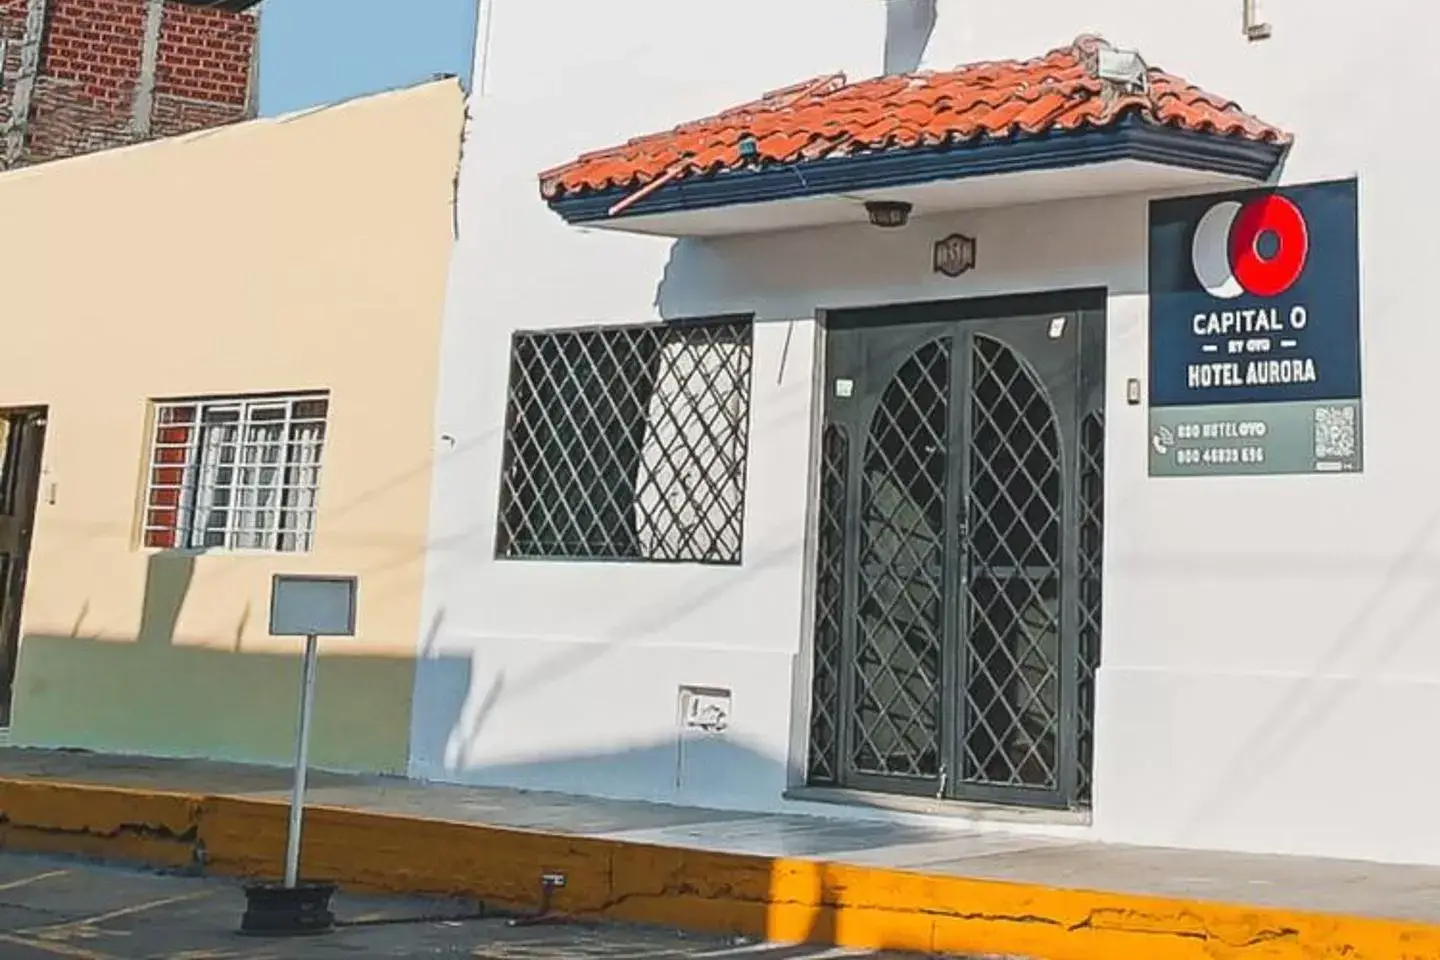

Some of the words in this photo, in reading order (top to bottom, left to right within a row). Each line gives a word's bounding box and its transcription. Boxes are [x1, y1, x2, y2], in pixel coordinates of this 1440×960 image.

[1192, 307, 1284, 336] CAPITAL
[1289, 304, 1307, 330] O
[1187, 362, 1243, 389] HOTEL
[1246, 357, 1317, 385] AURORA
